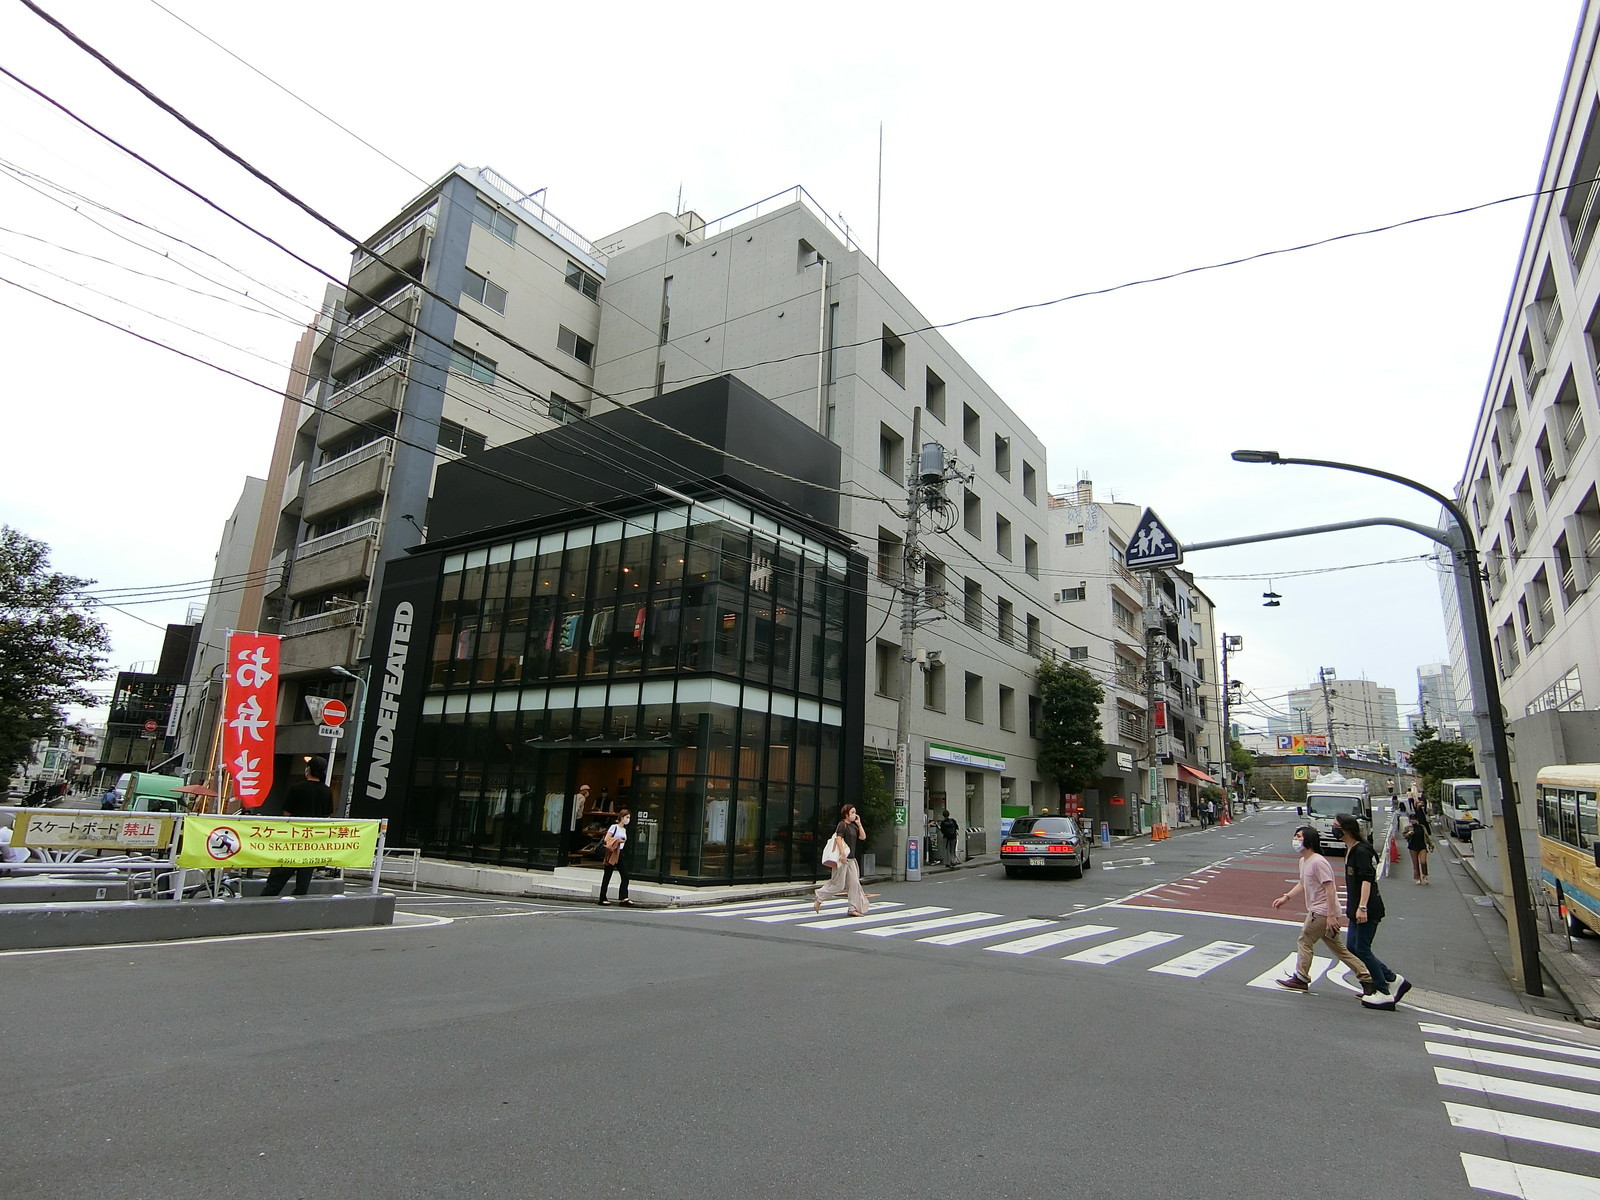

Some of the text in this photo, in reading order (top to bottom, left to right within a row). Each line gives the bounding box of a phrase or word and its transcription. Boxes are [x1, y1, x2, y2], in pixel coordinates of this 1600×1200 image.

[366, 601, 414, 800] UNDEFEATED
[1278, 736, 1289, 749] P
[249, 826, 361, 839] スケートボード禁止
[249, 841, 360, 851] NO SKATEBOARDING
